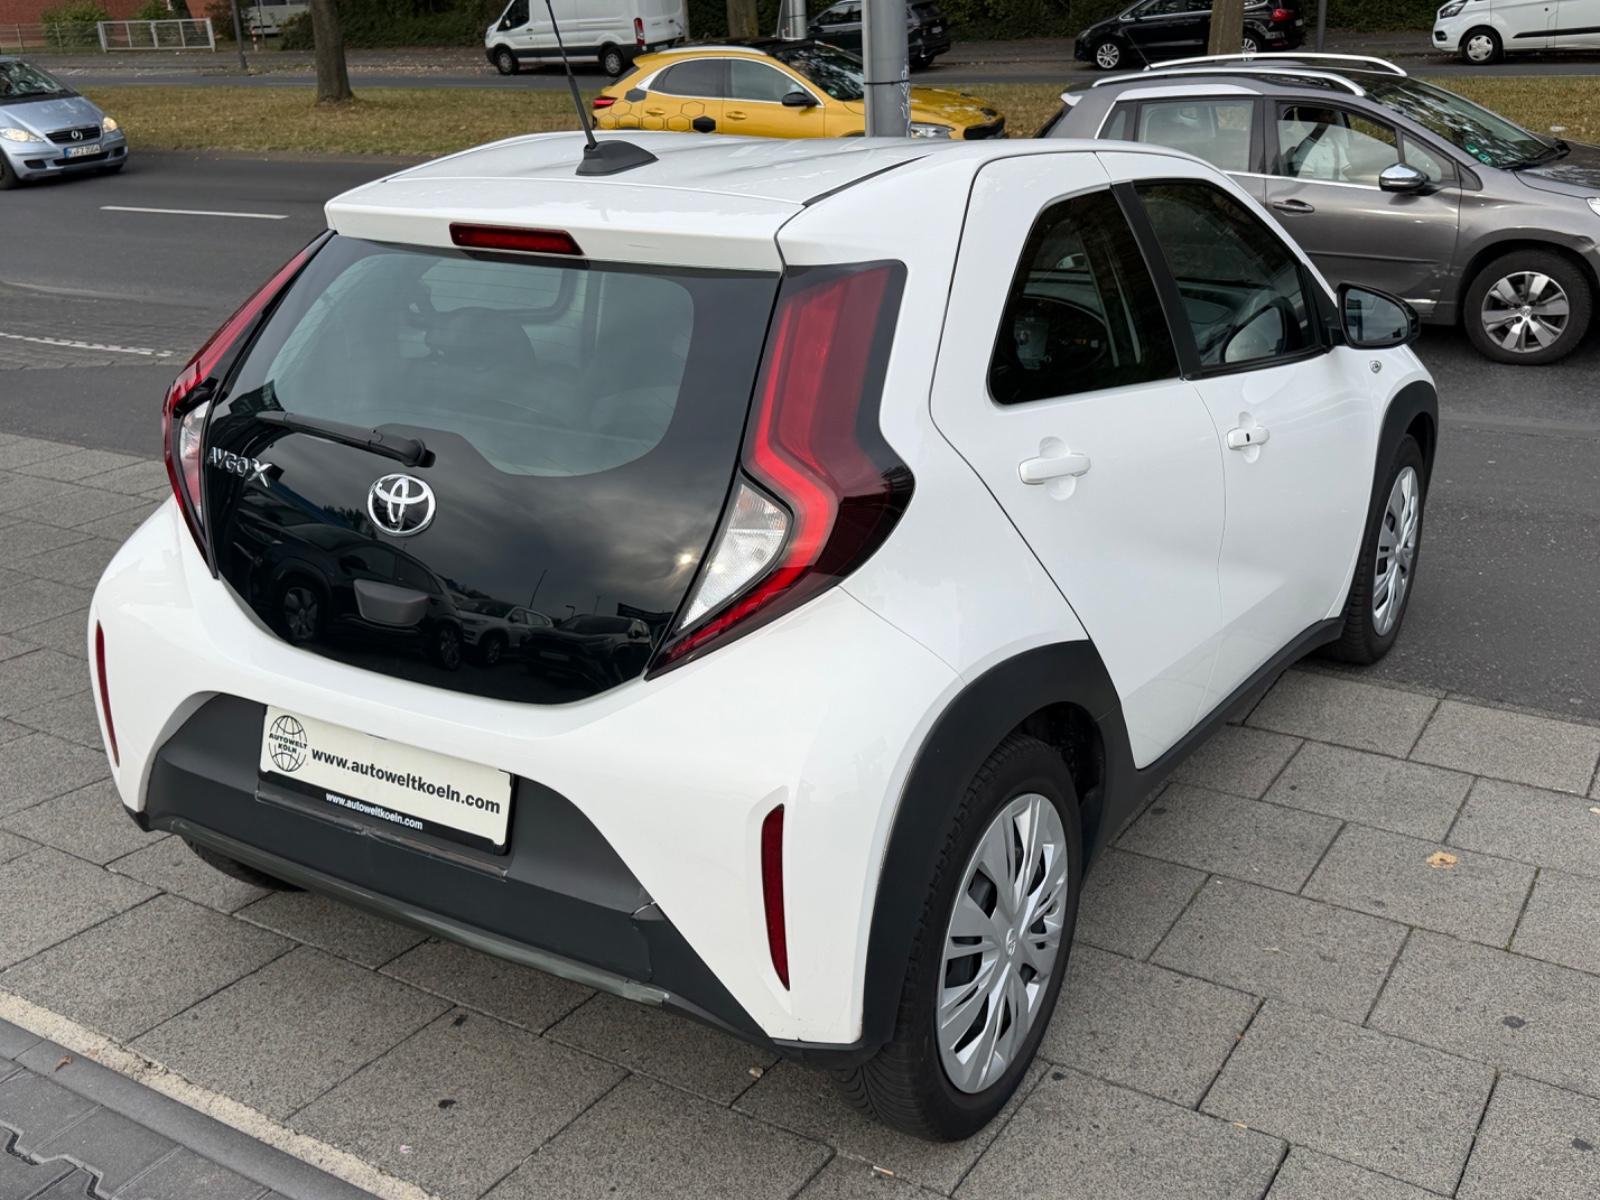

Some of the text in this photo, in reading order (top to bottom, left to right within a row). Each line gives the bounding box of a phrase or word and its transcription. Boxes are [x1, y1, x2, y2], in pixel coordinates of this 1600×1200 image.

[268, 733, 308, 750] AUTOWELT
[311, 748, 501, 814] www.autoweltkoeln.com
[325, 792, 423, 831] www.autoweltkoeln.com
